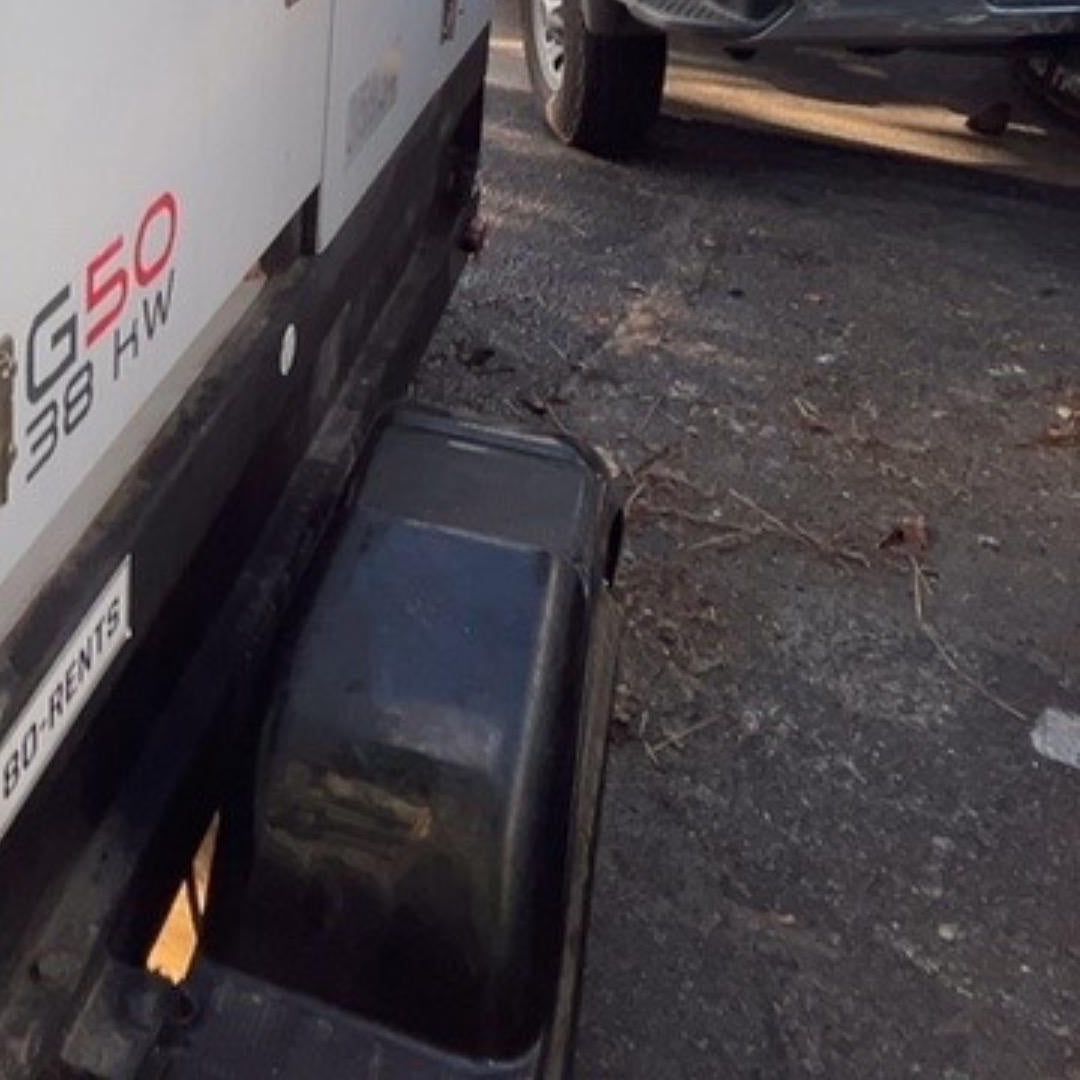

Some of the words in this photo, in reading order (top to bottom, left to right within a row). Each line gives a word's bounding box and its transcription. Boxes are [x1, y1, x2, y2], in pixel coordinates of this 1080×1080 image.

[25, 359, 93, 483] 38
[113, 268, 175, 382] HW
[26, 191, 178, 405] G50
